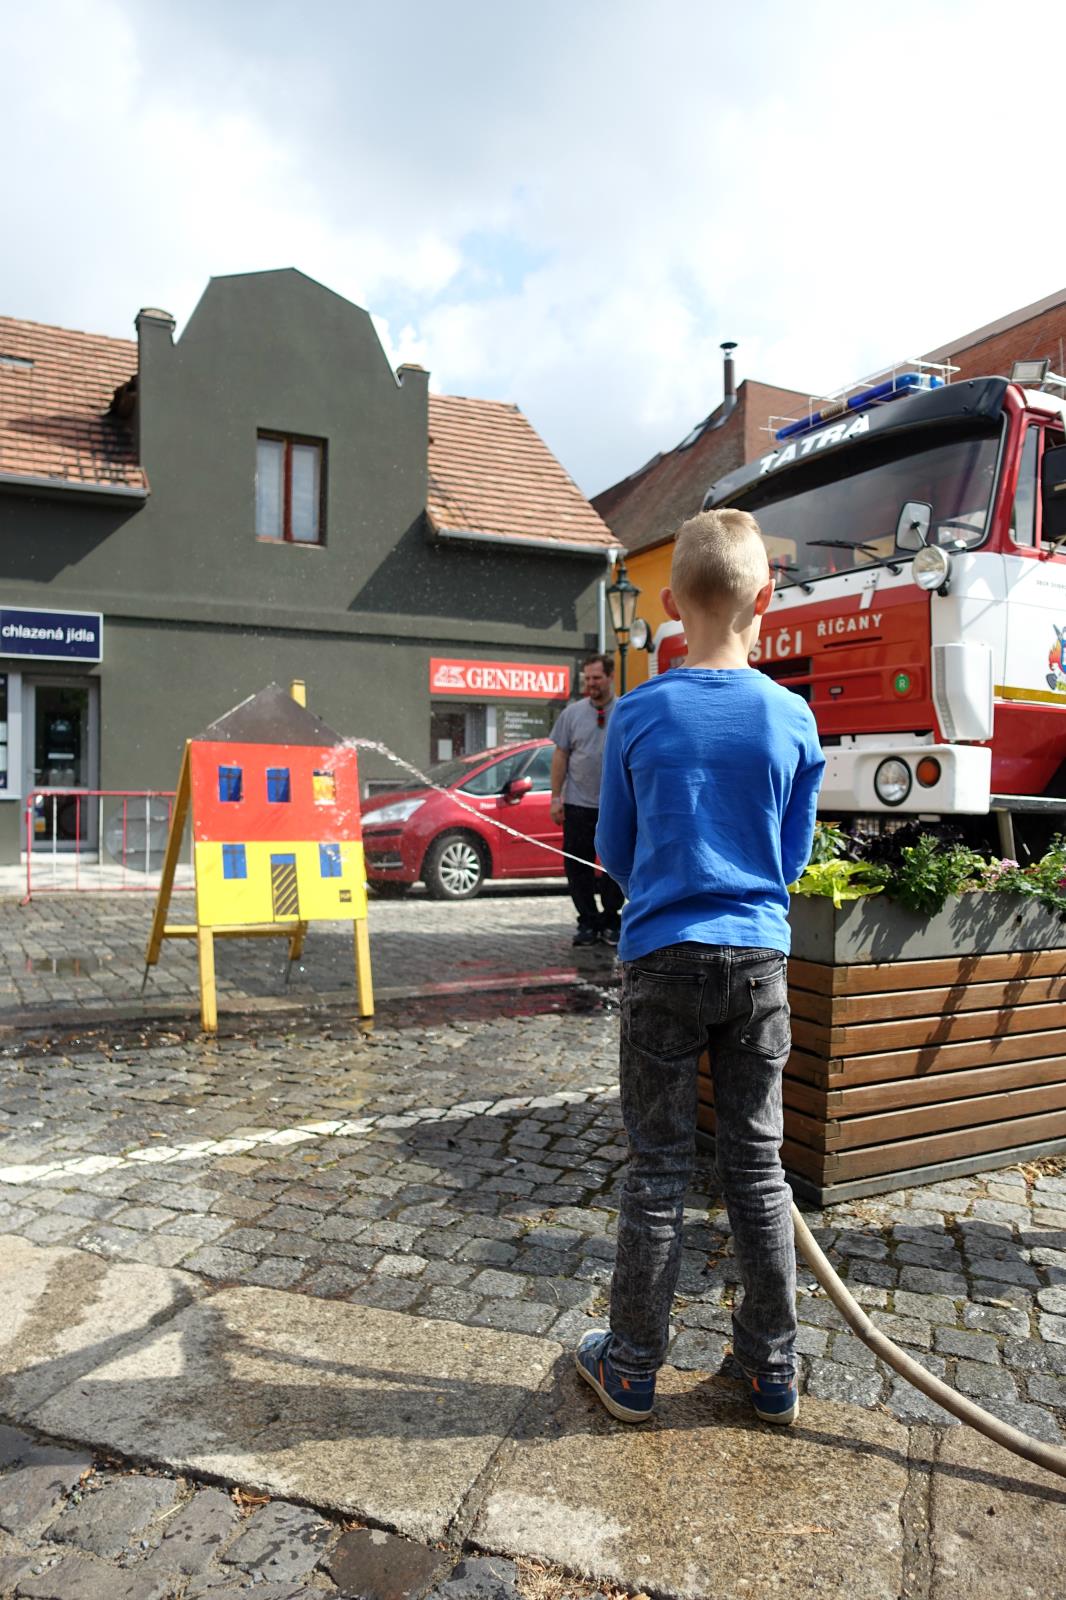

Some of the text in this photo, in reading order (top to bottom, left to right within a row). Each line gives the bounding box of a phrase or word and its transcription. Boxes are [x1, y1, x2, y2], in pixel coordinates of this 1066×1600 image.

[759, 414, 870, 474] TATRA
[1, 624, 95, 644] chlazená jídla
[816, 613, 882, 637] ŘÍČANY
[749, 628, 802, 662] SIČI
[466, 667, 566, 693] GENERALI
